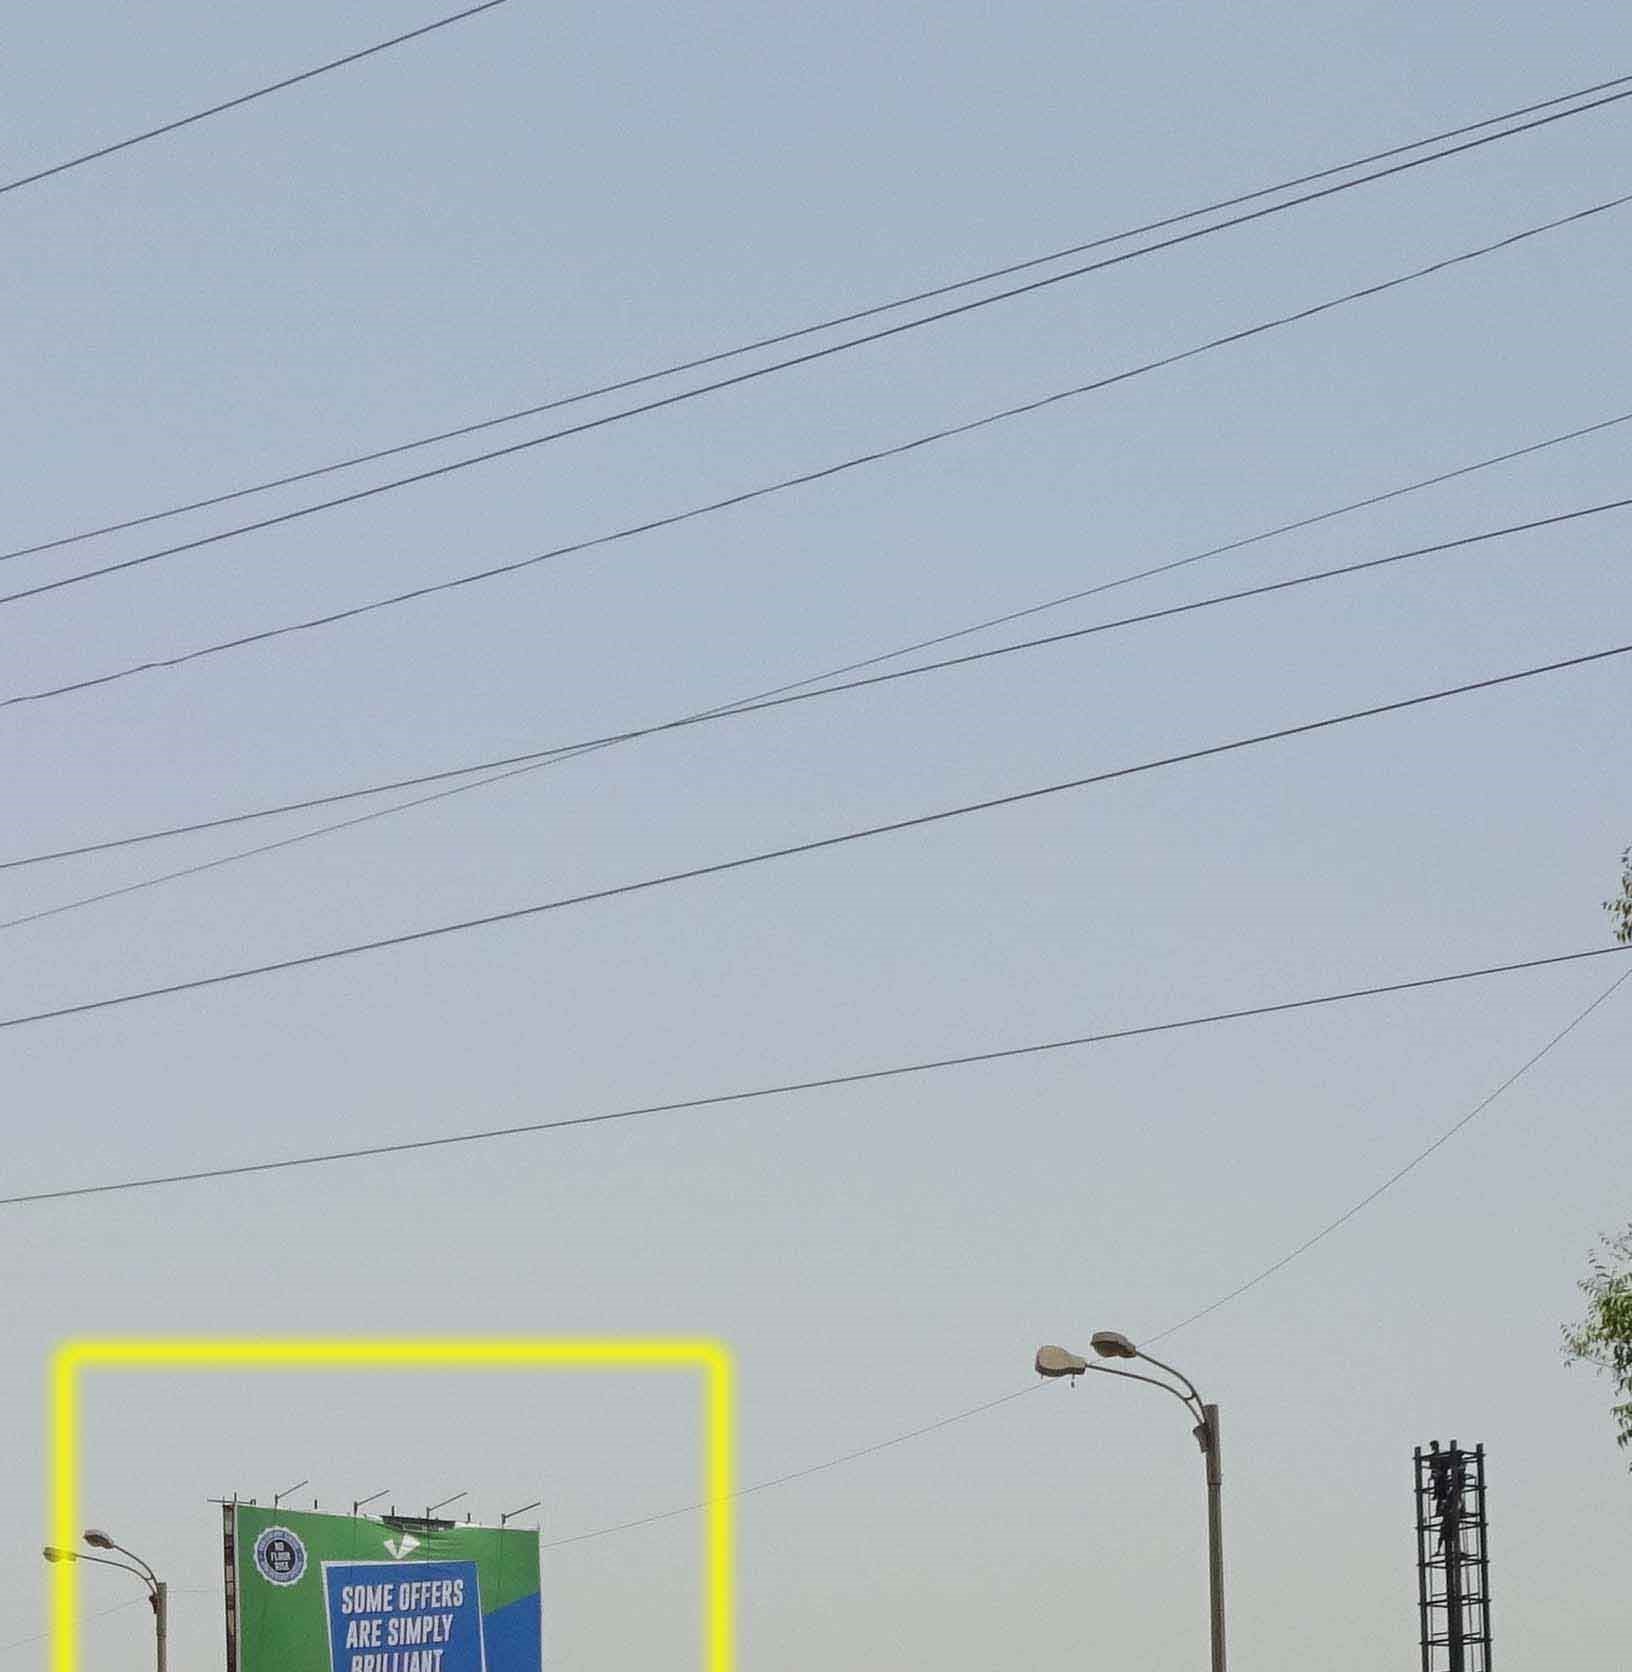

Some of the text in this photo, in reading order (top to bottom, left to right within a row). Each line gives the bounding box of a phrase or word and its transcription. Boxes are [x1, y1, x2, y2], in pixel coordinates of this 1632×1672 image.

[342, 1579, 464, 1614] SOME OFFERS
[346, 1614, 453, 1649] ARE SIMPLY
